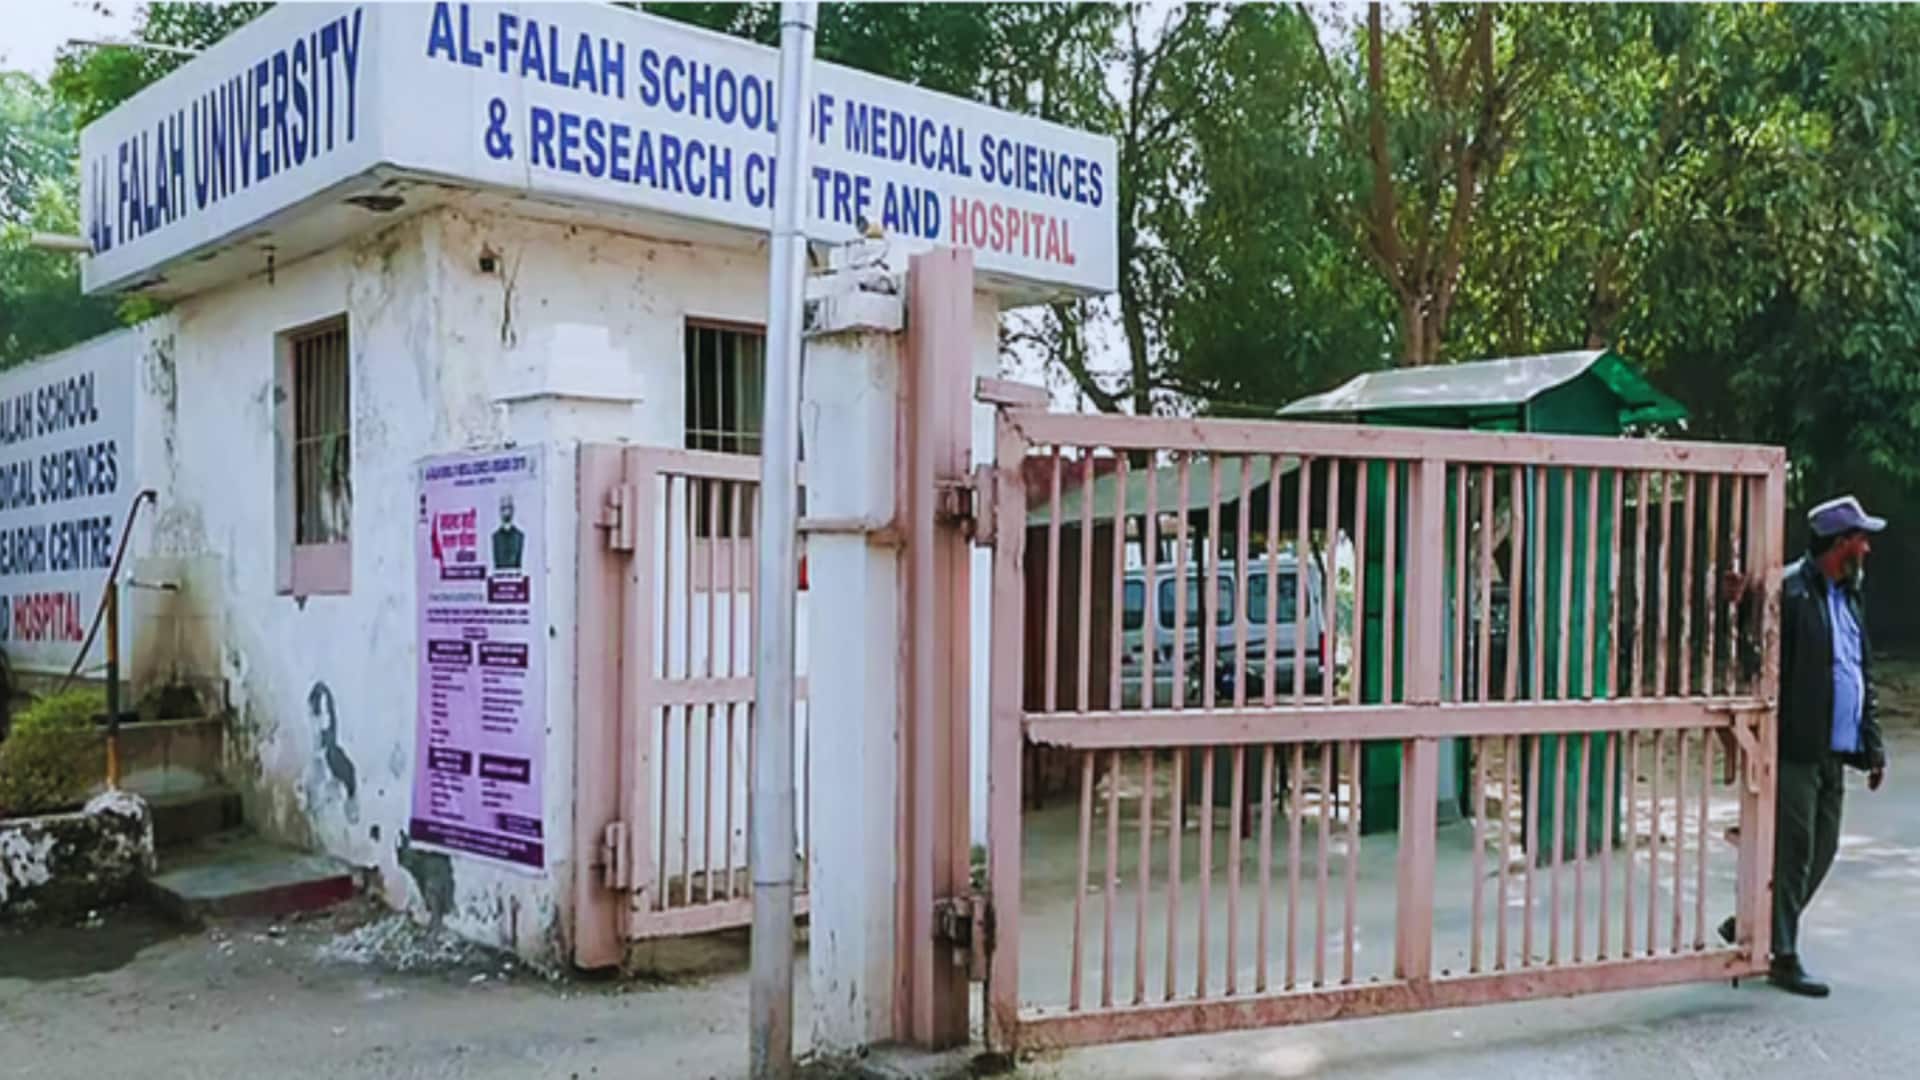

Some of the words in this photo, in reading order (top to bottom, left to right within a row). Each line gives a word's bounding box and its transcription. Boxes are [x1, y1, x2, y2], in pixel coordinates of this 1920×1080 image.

[118, 110, 186, 246] FALAH
[192, 7, 362, 210] UNIVERSITY
[427, 1, 625, 99] AL-FALAH
[640, 49, 778, 134] SCHOOL
[811, 93, 834, 145] F
[845, 100, 972, 177] MEDICAL
[980, 134, 1103, 208] SCIENCES
[485, 98, 514, 160] &
[531, 106, 732, 202] RESEARCH
[744, 152, 871, 225] CTRE
[882, 181, 941, 239] AND
[951, 196, 1076, 265] HOSPITAL
[37, 371, 98, 436] SCHOOL
[40, 440, 117, 504] SCIENCES
[49, 516, 112, 571] CENTRE
[13, 592, 84, 641] HOSPITAL
